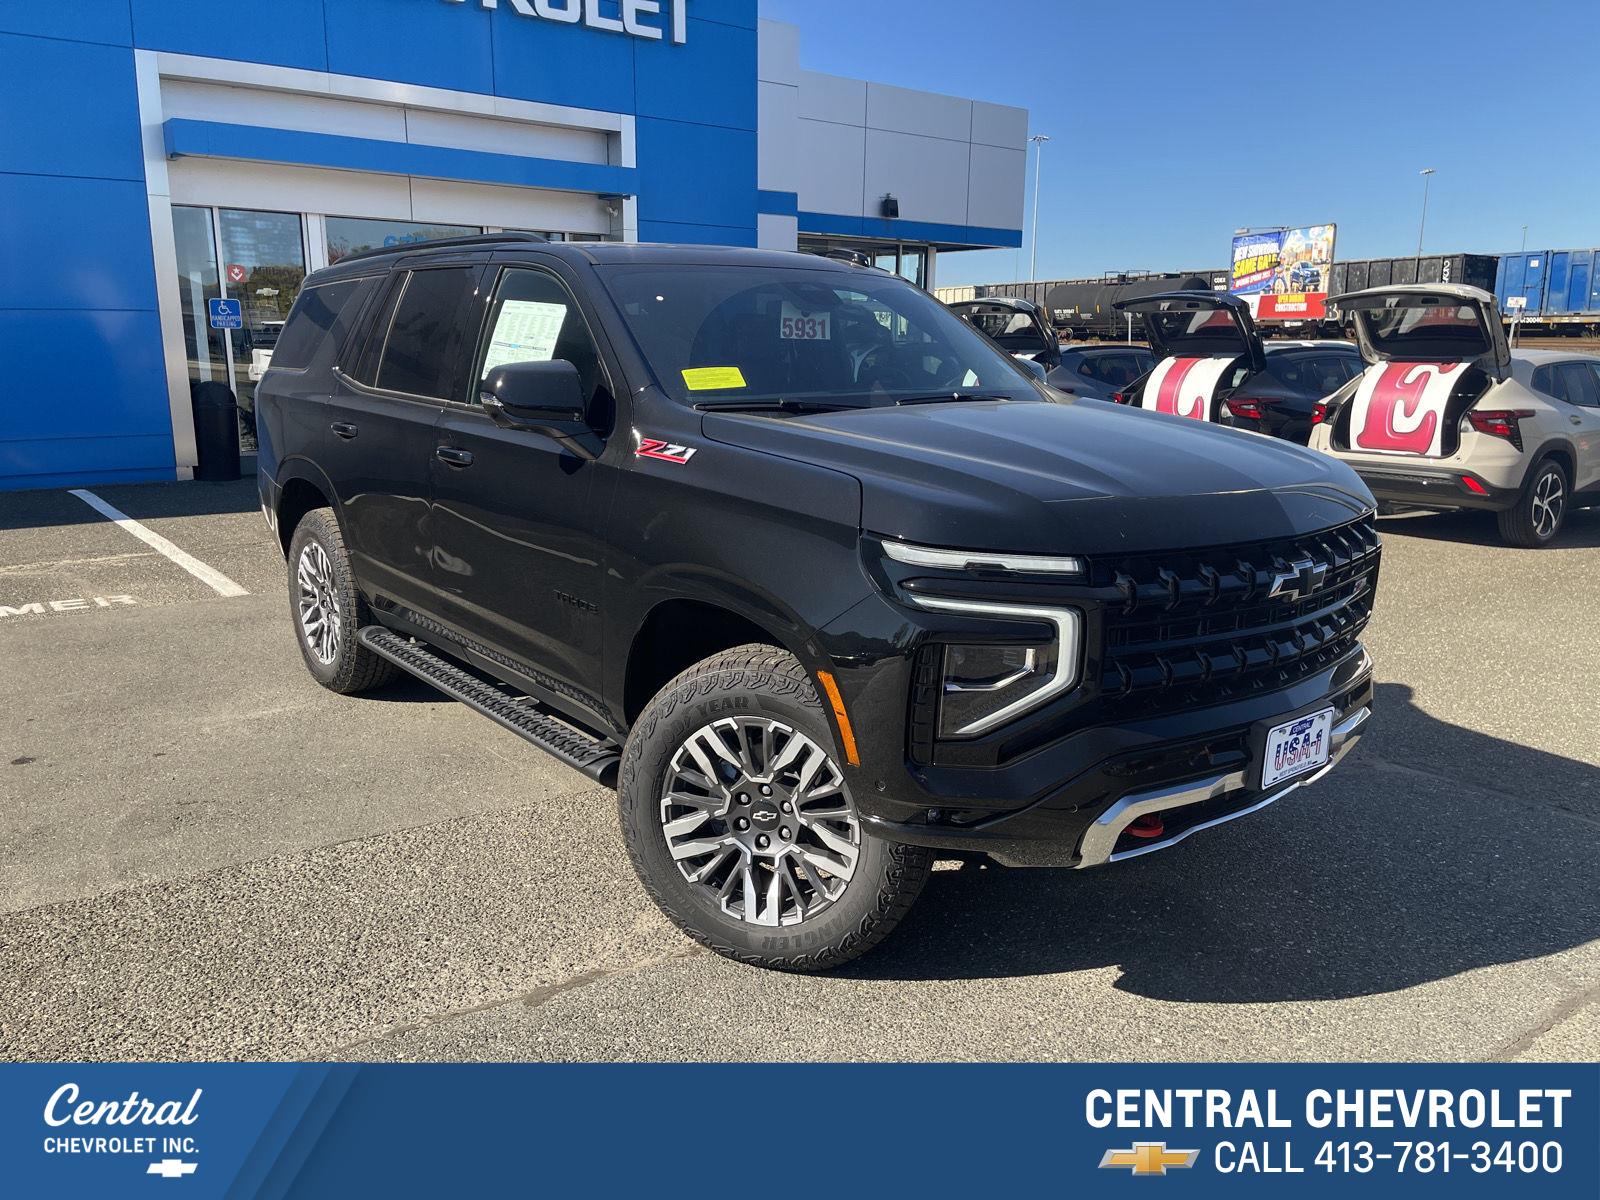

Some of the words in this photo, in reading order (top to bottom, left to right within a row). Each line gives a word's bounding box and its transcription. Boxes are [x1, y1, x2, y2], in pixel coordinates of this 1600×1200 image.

[1232, 257, 1258, 279] SAME
[782, 318, 827, 339] 5931
[1292, 722, 1311, 733] CENTRAL
[1274, 729, 1322, 771] USA-1
